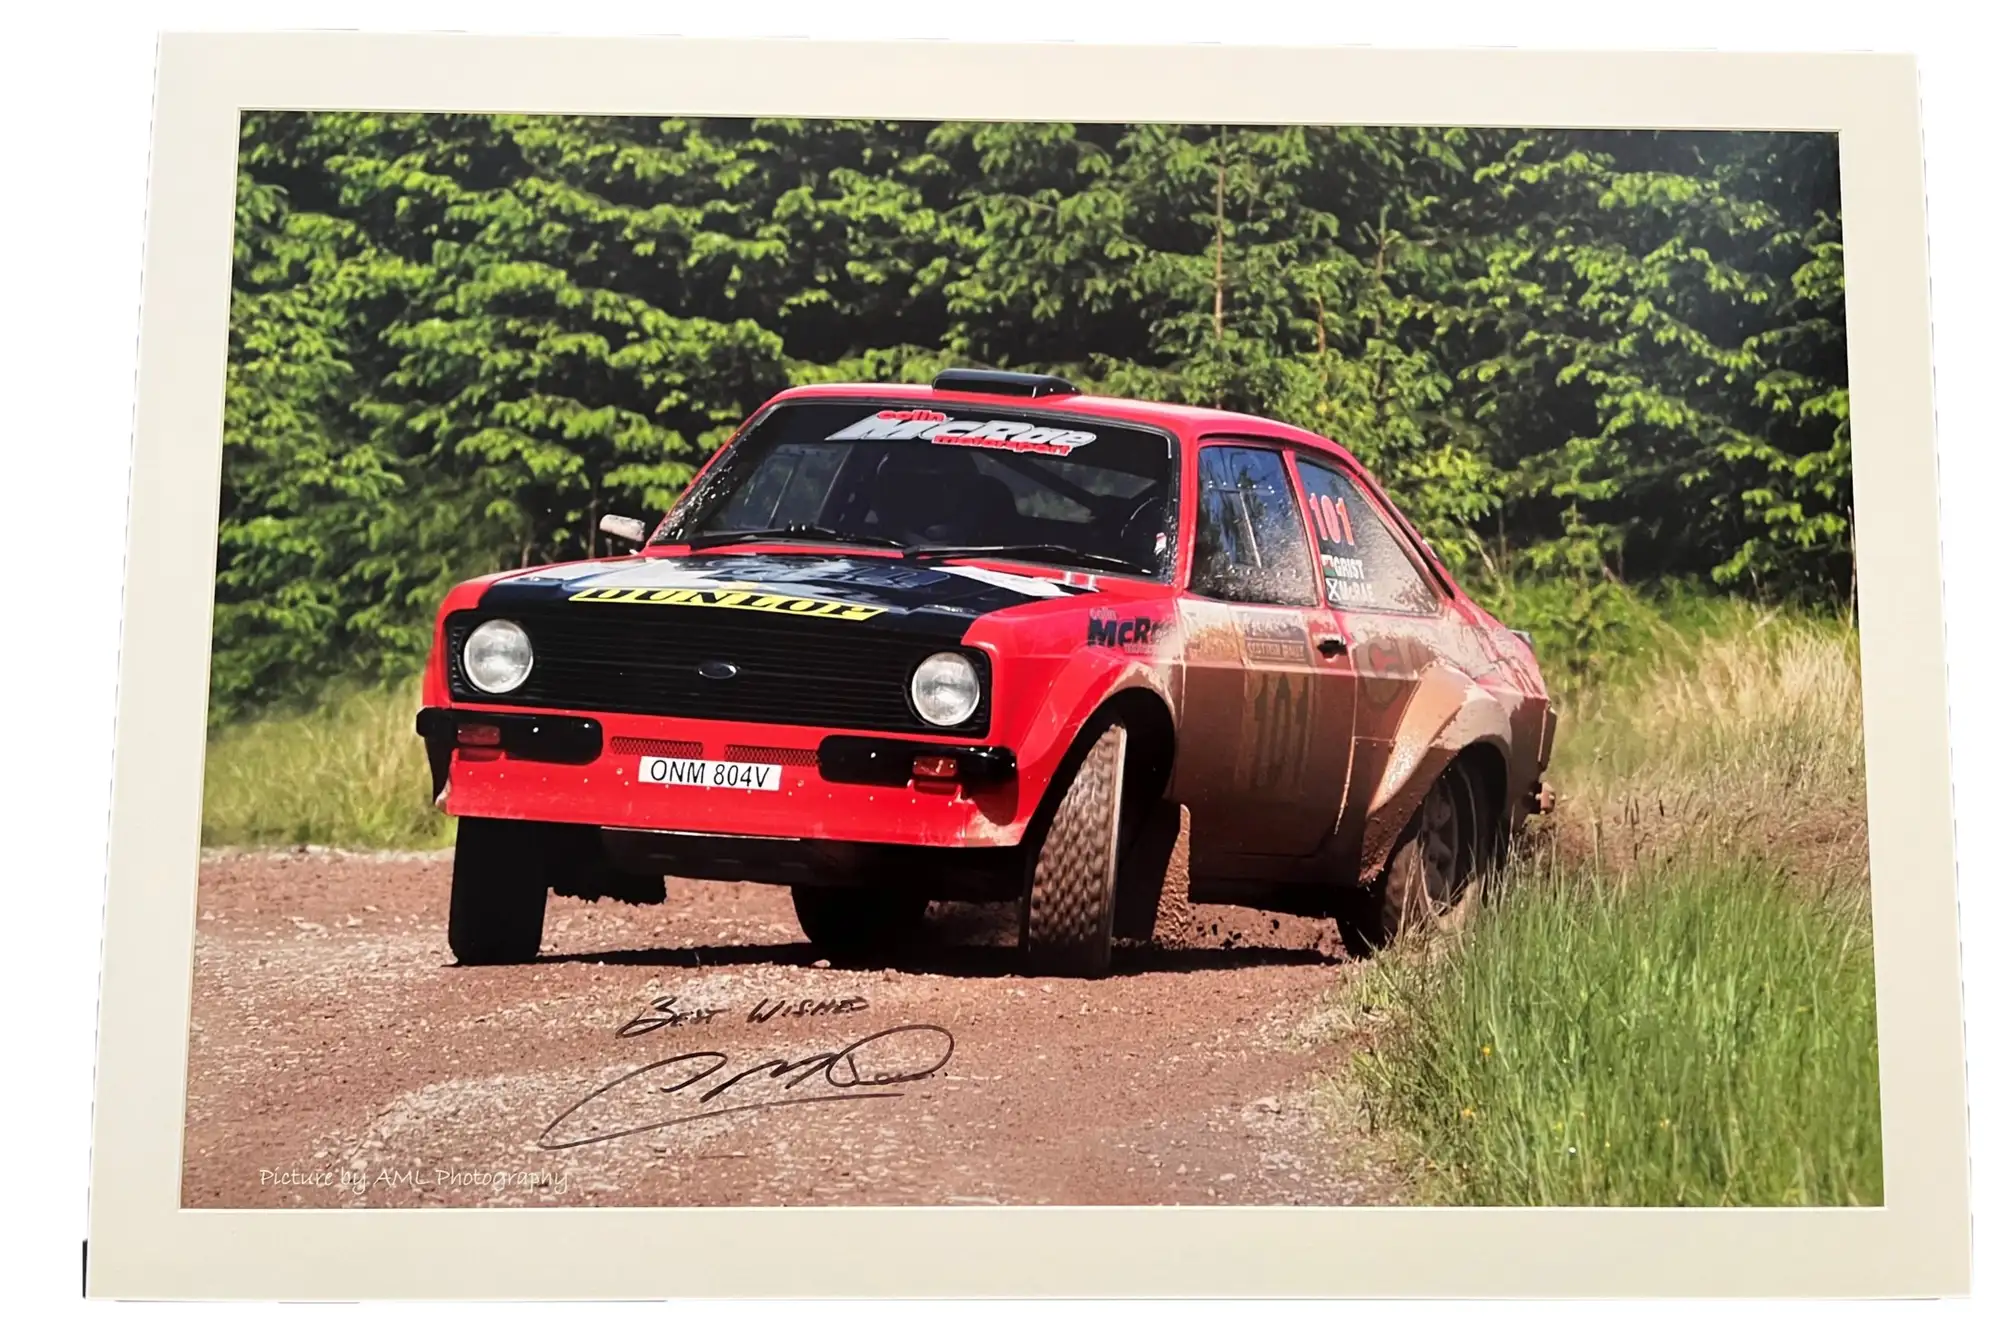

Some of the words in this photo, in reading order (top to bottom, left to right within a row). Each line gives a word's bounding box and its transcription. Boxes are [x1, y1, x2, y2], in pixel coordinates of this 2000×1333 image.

[877, 409, 946, 422] colin
[932, 435, 1073, 456] motorsport
[1309, 493, 1354, 546] 101
[1334, 556, 1365, 580] GRIST
[579, 589, 877, 618] DUNLOP
[651, 759, 706, 784] ONM
[713, 763, 770, 788] 804V
